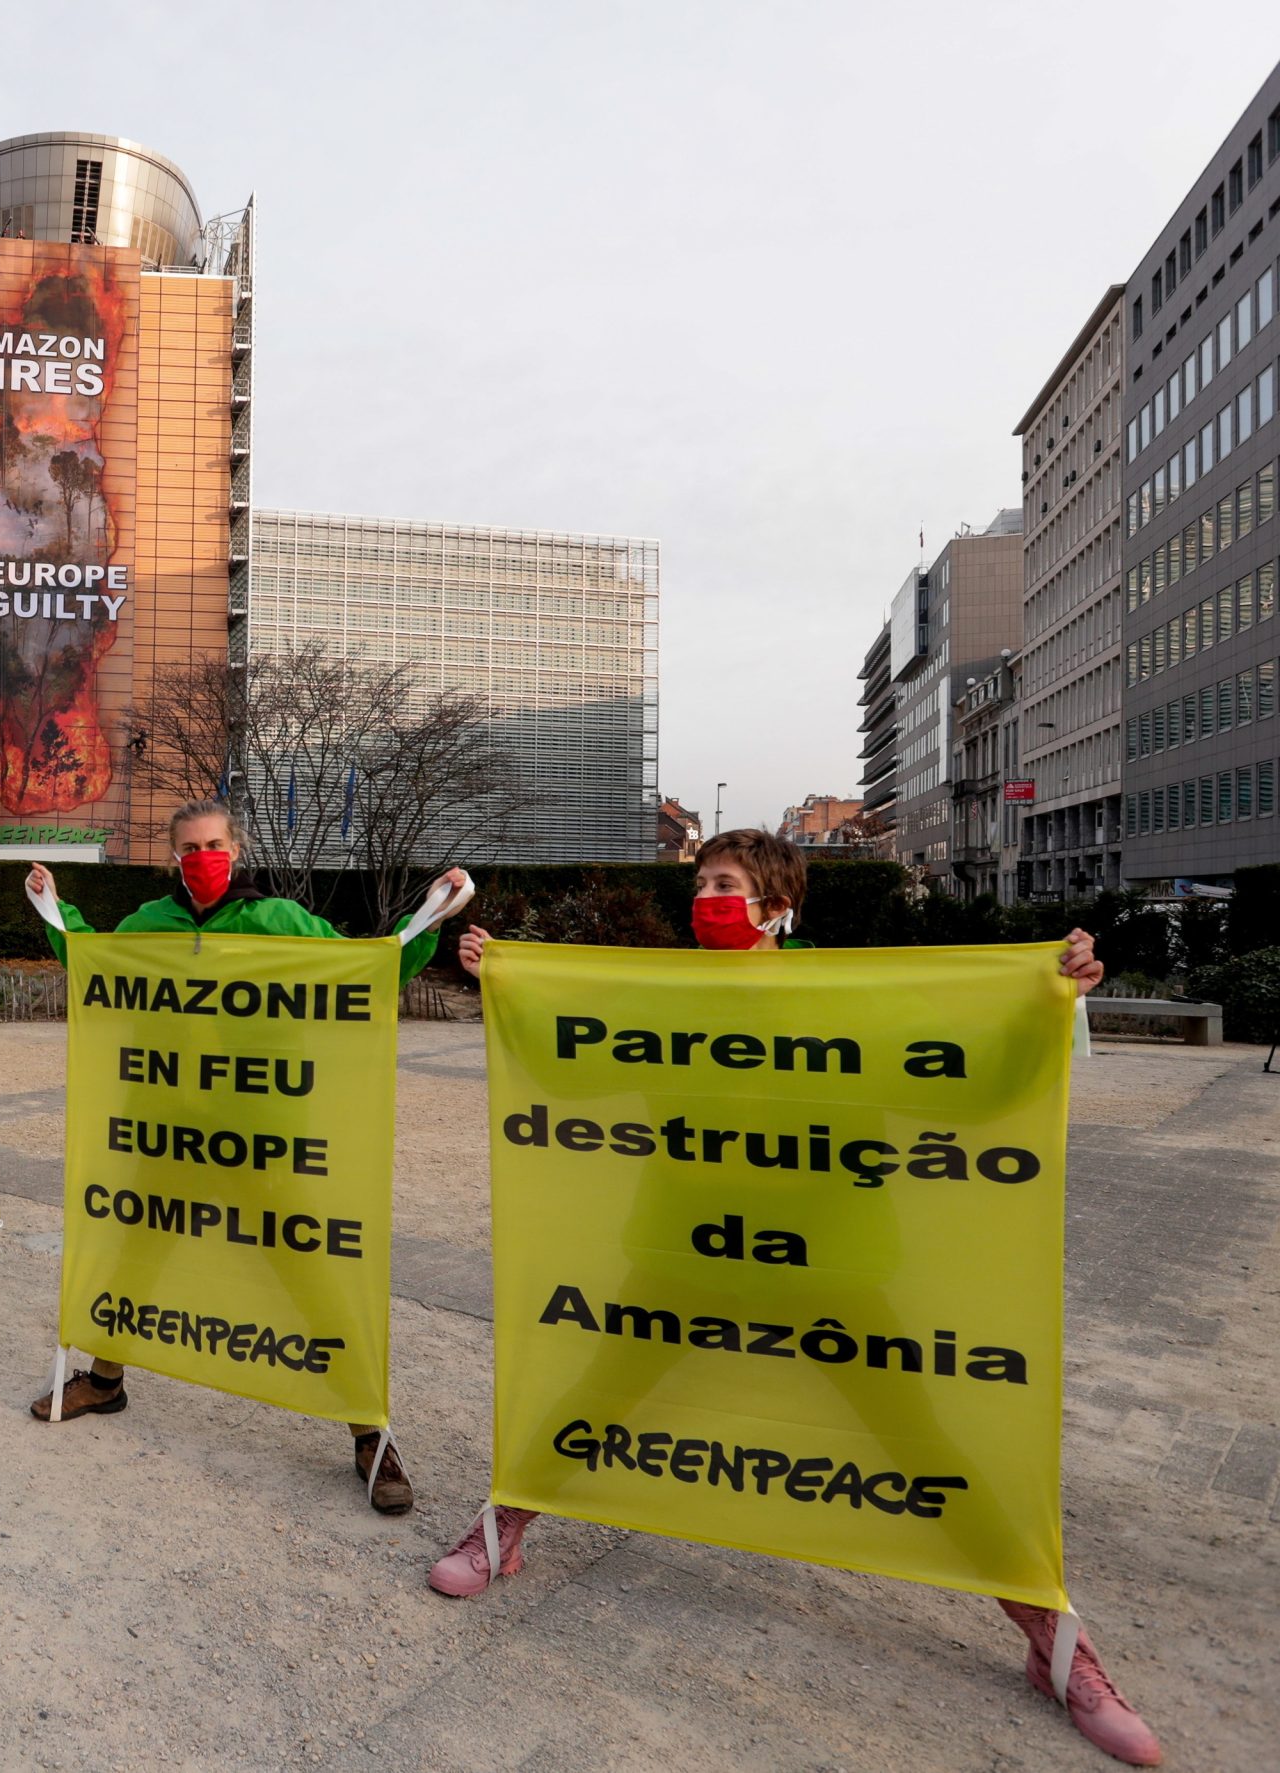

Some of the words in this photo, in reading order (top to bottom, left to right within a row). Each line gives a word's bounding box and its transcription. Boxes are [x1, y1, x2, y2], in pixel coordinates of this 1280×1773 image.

[84, 975, 370, 1021] AMAZONIE
[120, 1048, 178, 1086] EN
[200, 1055, 313, 1096] FEU
[557, 1016, 861, 1074] Parem
[904, 1041, 967, 1078] a
[109, 1118, 327, 1175] EUROPE
[504, 1105, 1040, 1188] destruição
[85, 1184, 362, 1258] COMPLICE
[692, 1215, 808, 1266] da
[88, 1292, 345, 1376] GREENPEACE
[539, 1285, 1027, 1384] Amazônia
[553, 1420, 968, 1518] GREENPEACE
